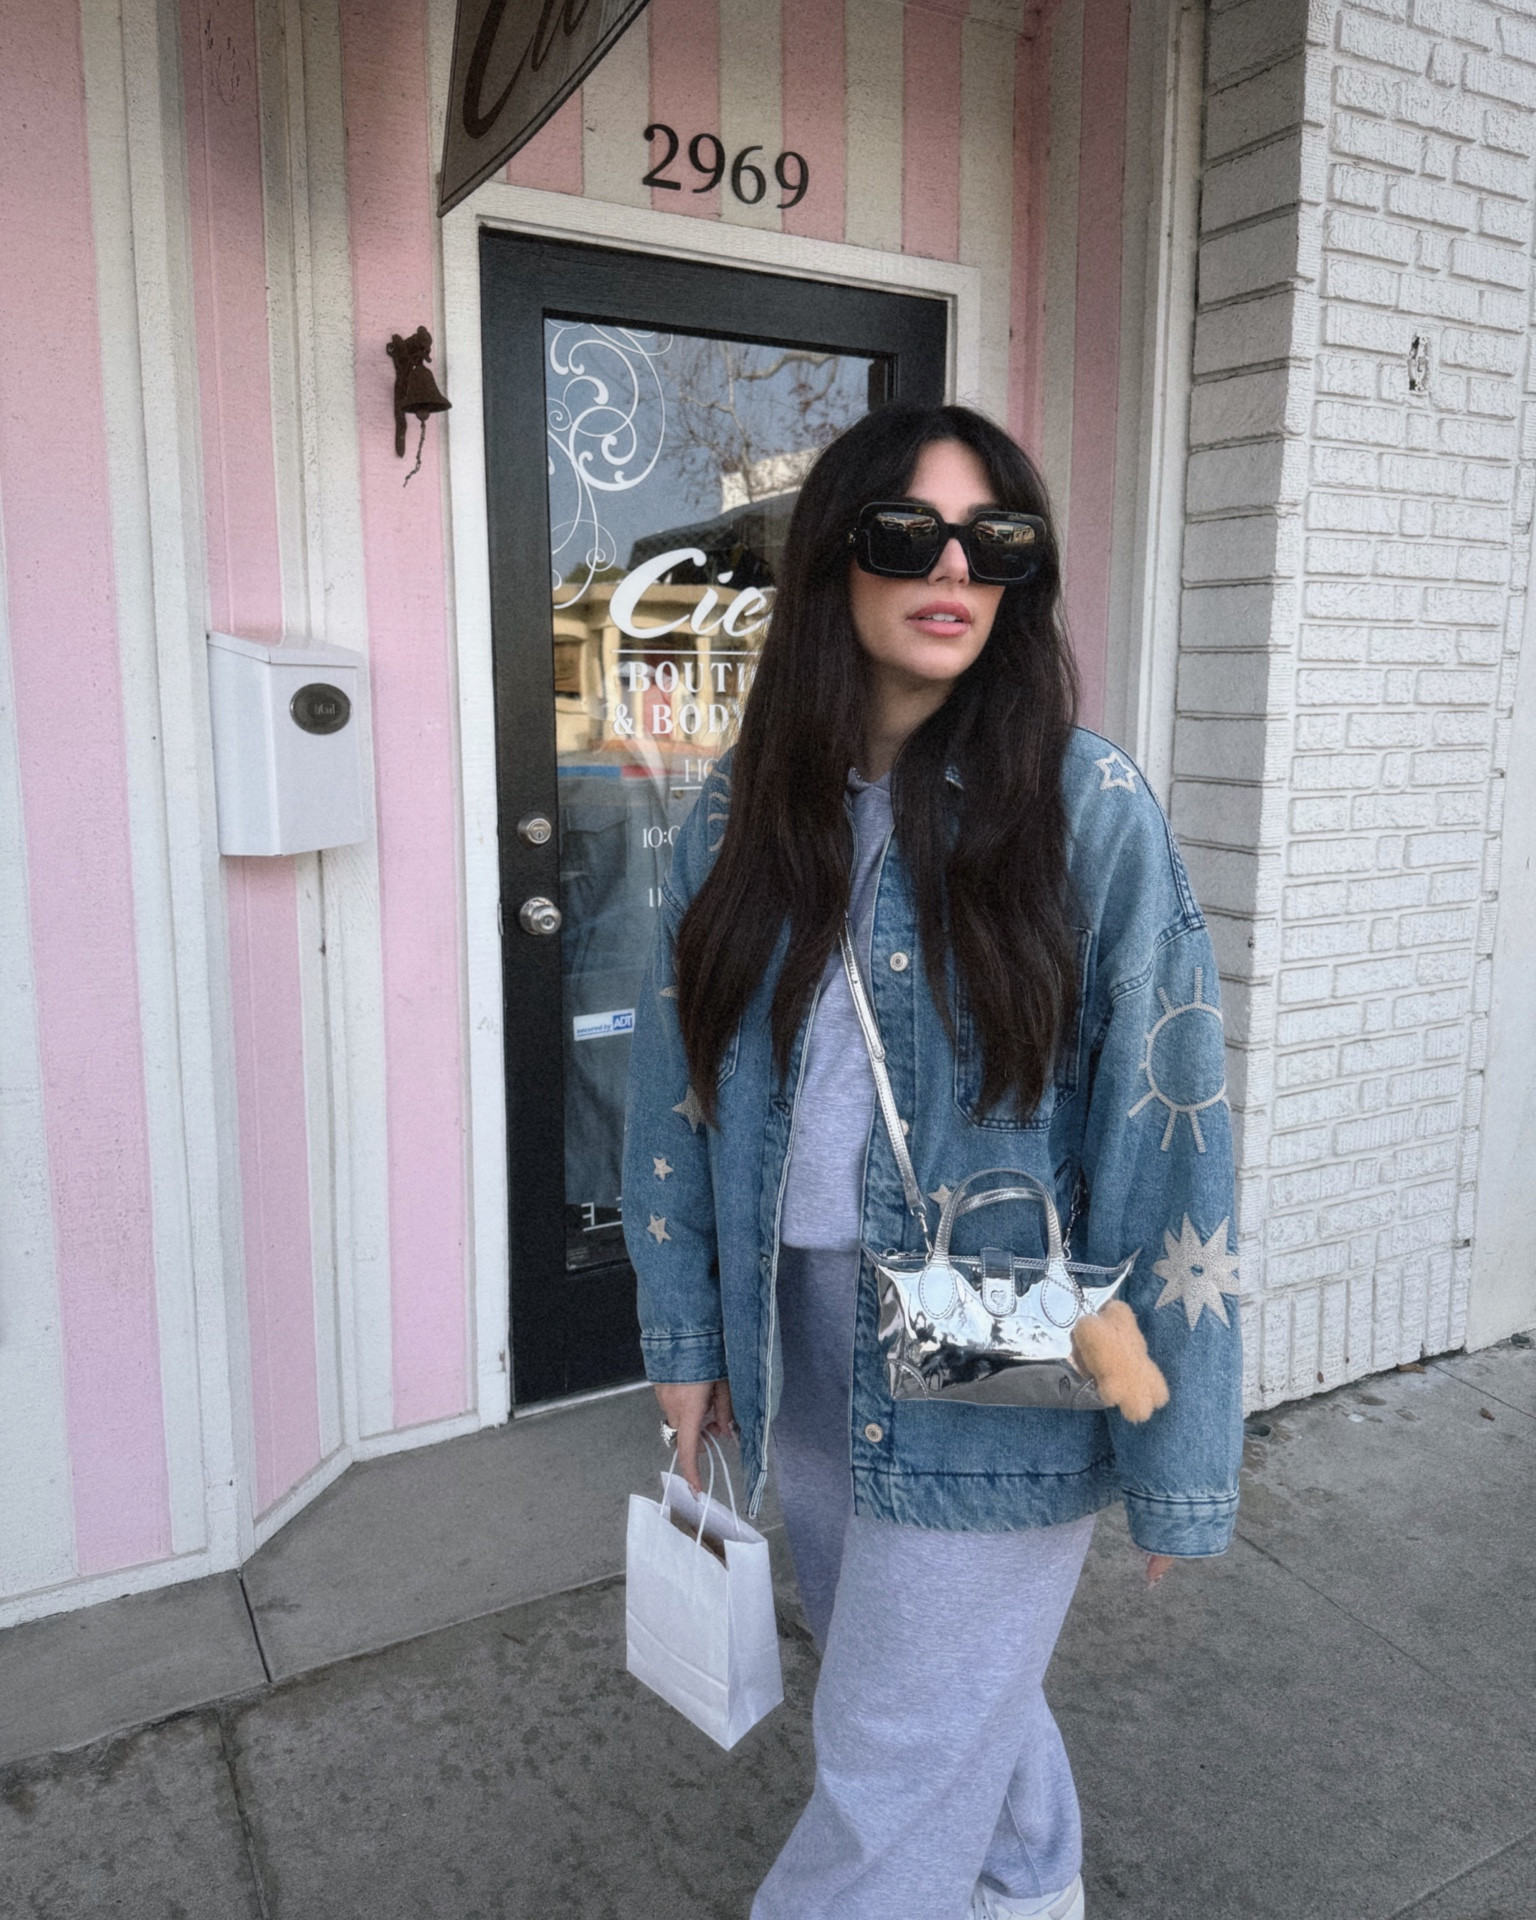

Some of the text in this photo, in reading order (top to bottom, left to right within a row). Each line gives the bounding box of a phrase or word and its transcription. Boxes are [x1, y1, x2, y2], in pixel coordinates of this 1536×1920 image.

[642, 123, 810, 209] 2969
[628, 660, 757, 693] BOUTI
[613, 703, 636, 735] &
[613, 1015, 633, 1029] ADT
